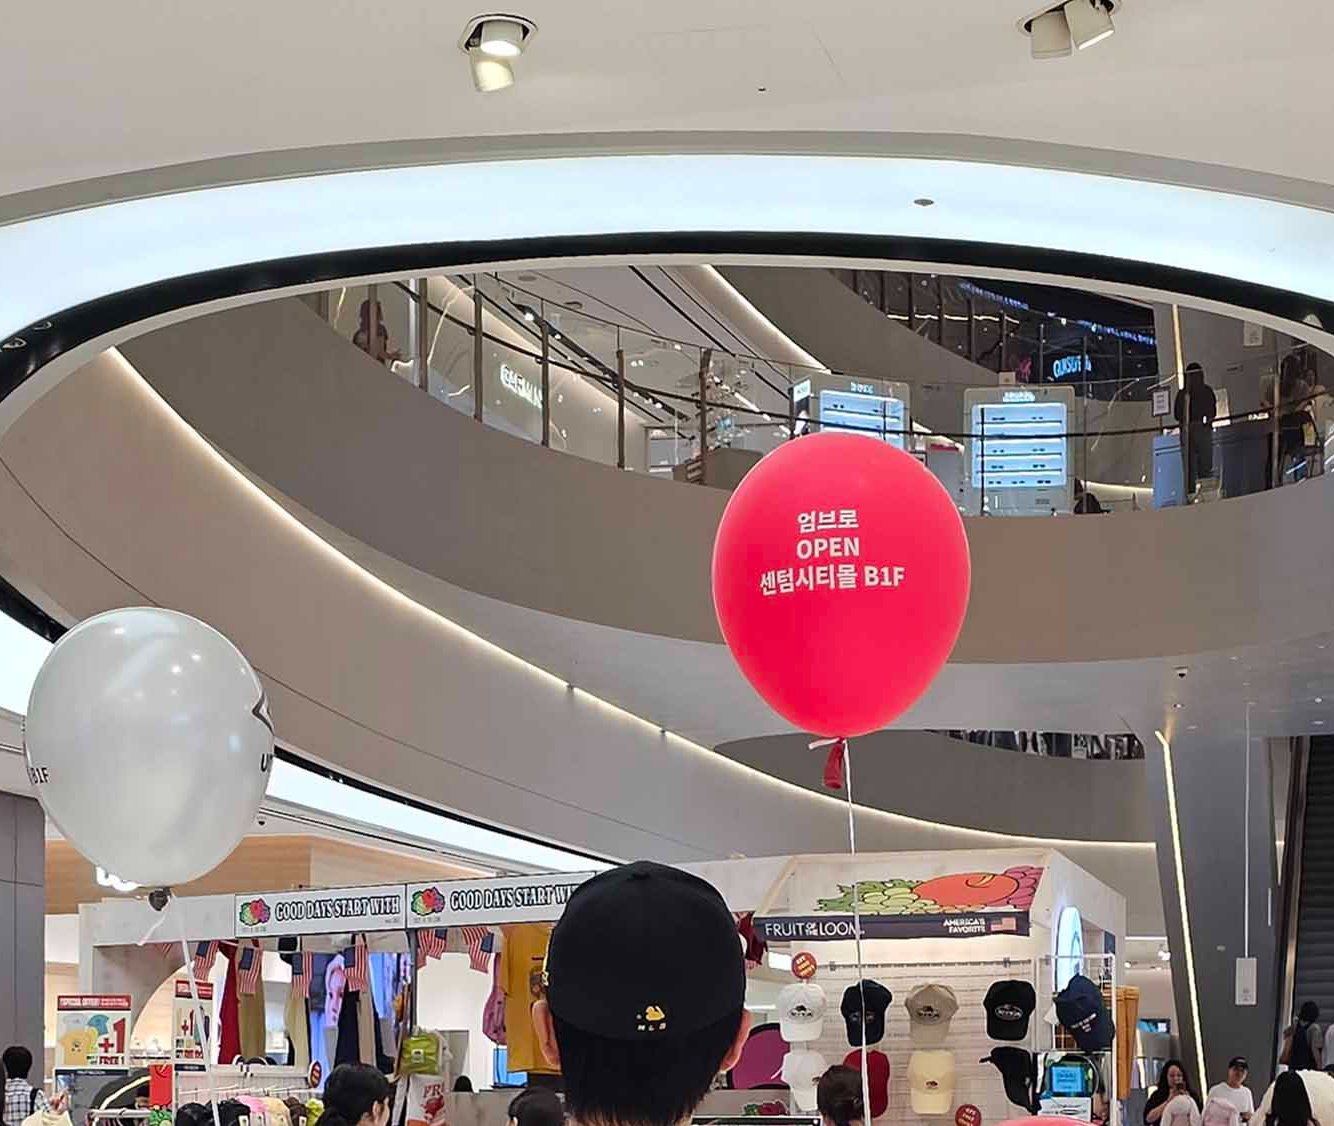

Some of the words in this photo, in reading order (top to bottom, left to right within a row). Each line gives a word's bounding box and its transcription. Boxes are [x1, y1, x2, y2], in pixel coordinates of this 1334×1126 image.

[797, 509, 859, 533] 엄브로
[796, 537, 860, 560] OPEN
[760, 563, 857, 595] 센텀시티몰
[864, 566, 904, 586] B1F
[275, 901, 306, 921] GOOD
[306, 900, 334, 919] DAYS
[334, 897, 369, 917] START
[369, 895, 400, 915] WITH
[450, 889, 482, 911] GOOD
[483, 887, 514, 908] DAYS
[515, 885, 554, 906] START
[765, 923, 804, 937] FRUIT
[637, 1022, 667, 1031] MLB
